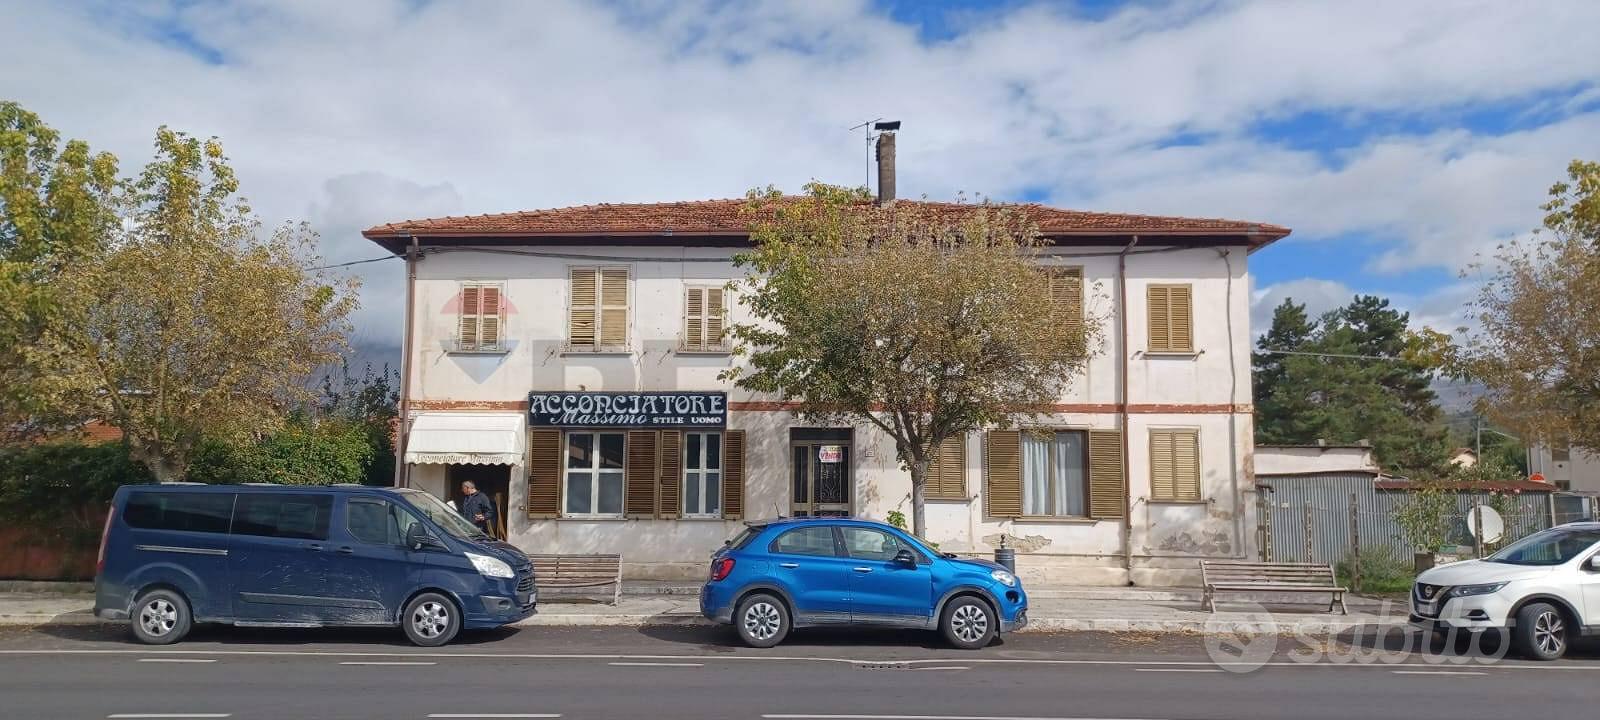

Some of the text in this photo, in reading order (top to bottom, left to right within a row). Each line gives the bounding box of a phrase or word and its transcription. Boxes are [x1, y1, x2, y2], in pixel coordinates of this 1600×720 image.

[530, 395, 725, 415] ACCONCIATORE
[550, 408, 722, 425] Massimo STILE UOMO
